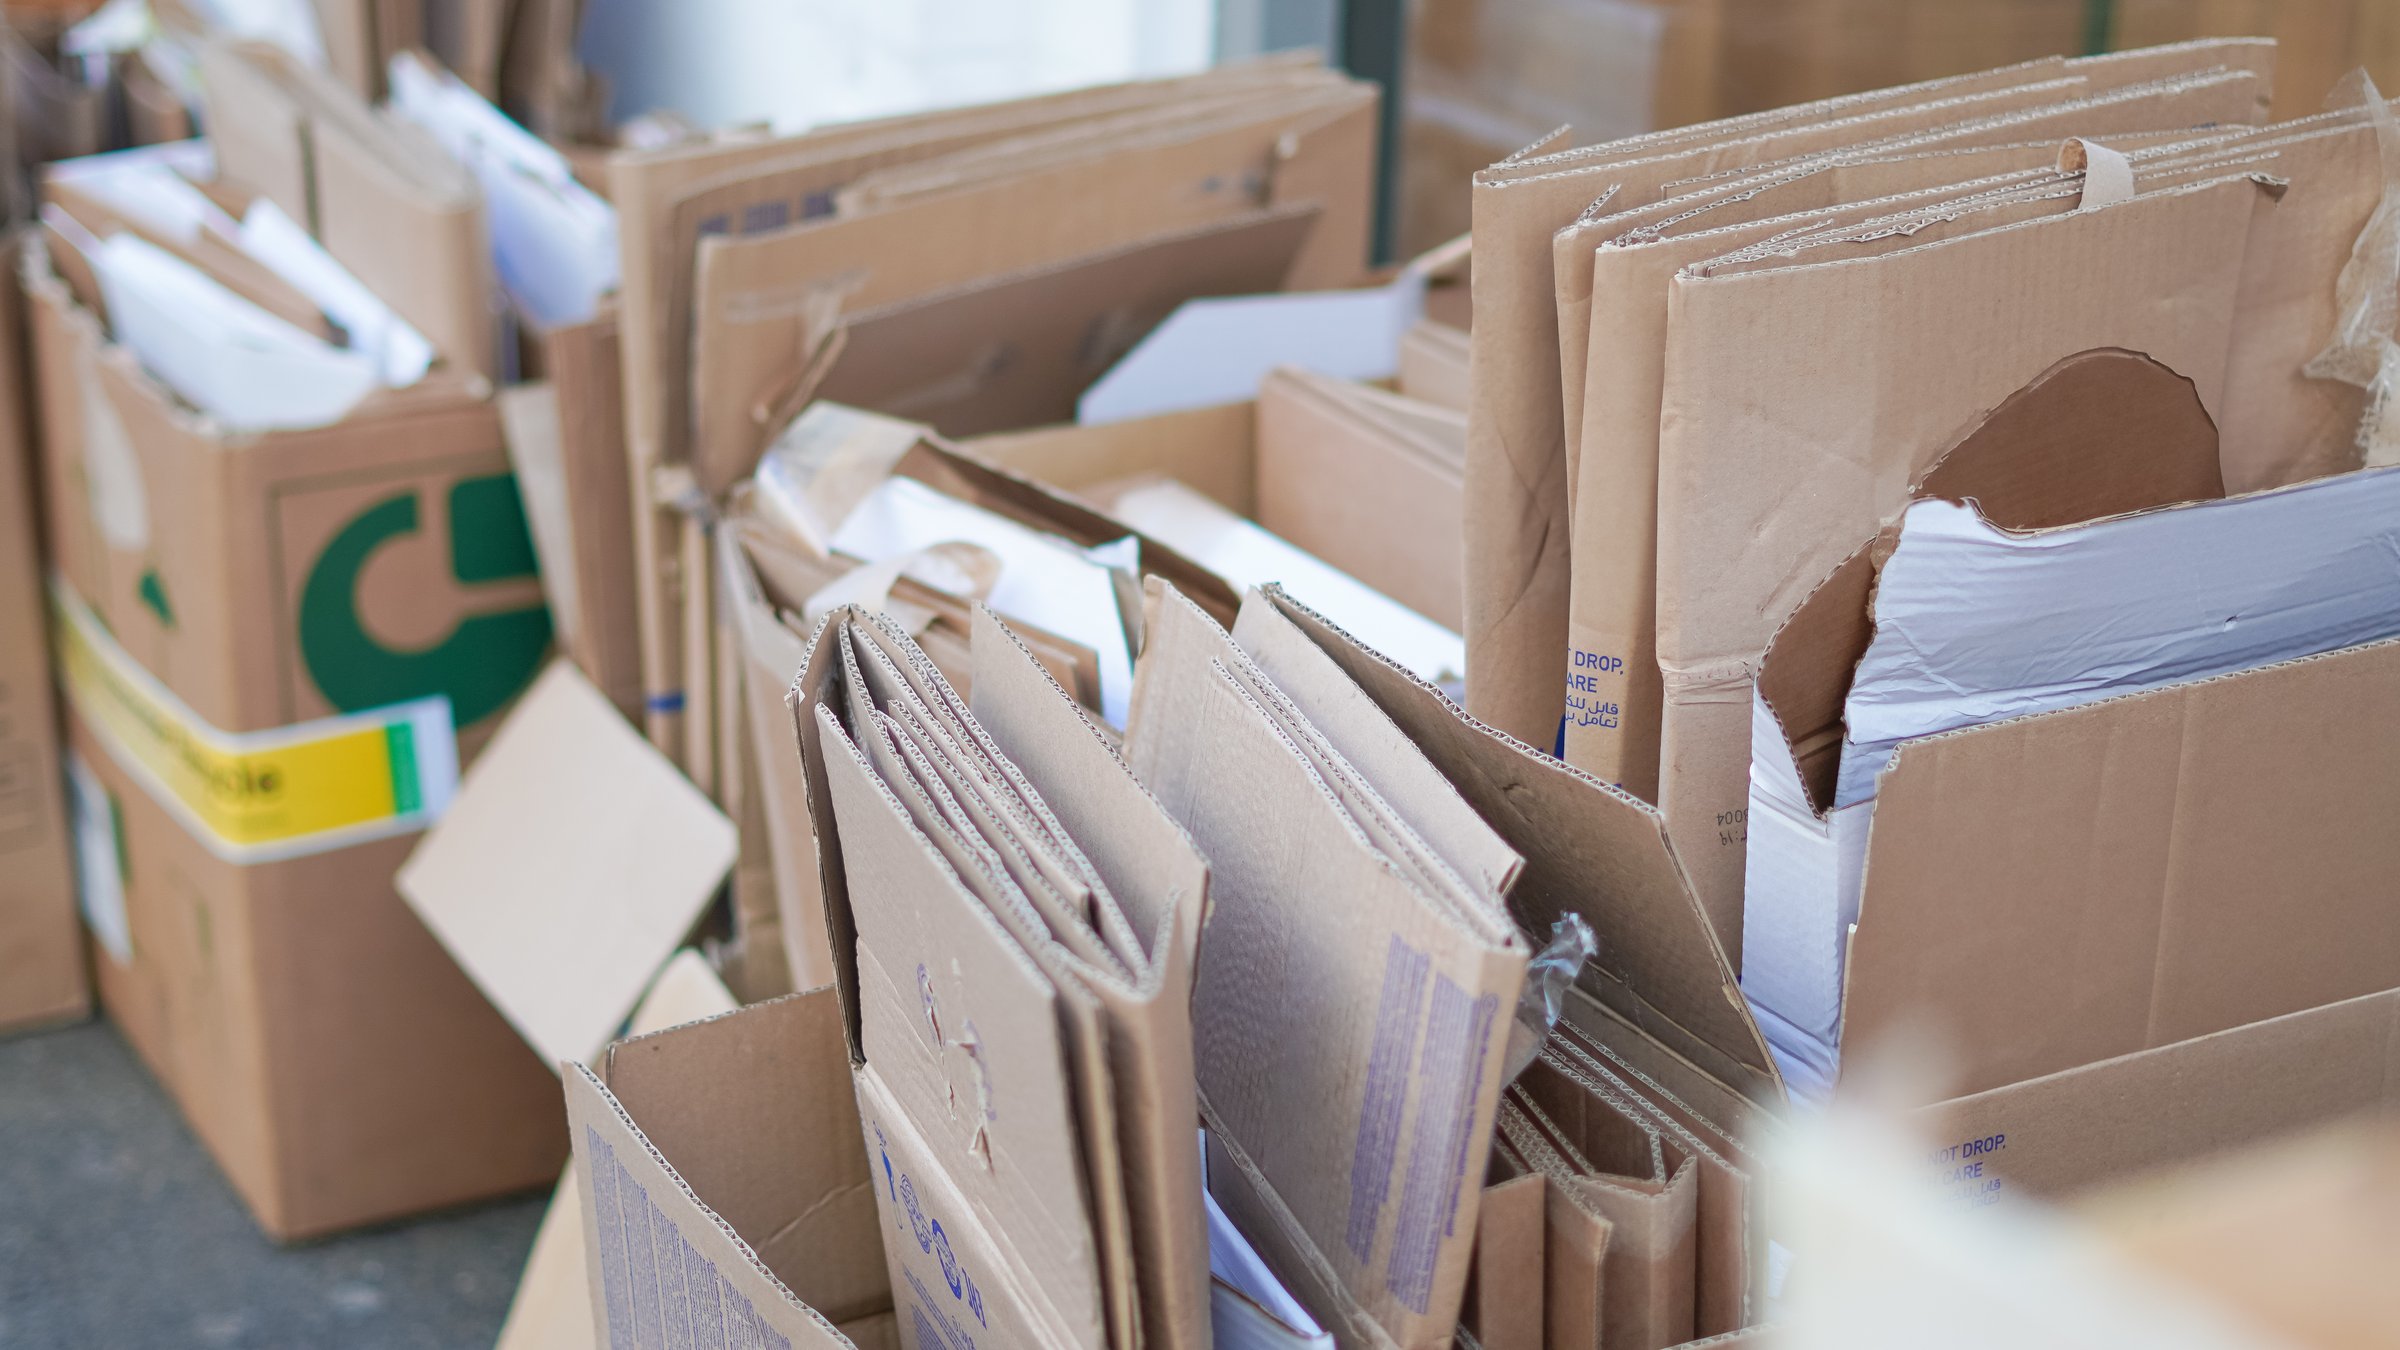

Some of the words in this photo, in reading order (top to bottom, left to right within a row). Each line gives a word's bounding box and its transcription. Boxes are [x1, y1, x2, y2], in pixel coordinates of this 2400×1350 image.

[1574, 650, 1624, 676] DROP.
[1566, 671, 1598, 694] ARE
[1962, 1133, 2007, 1159] DROP.
